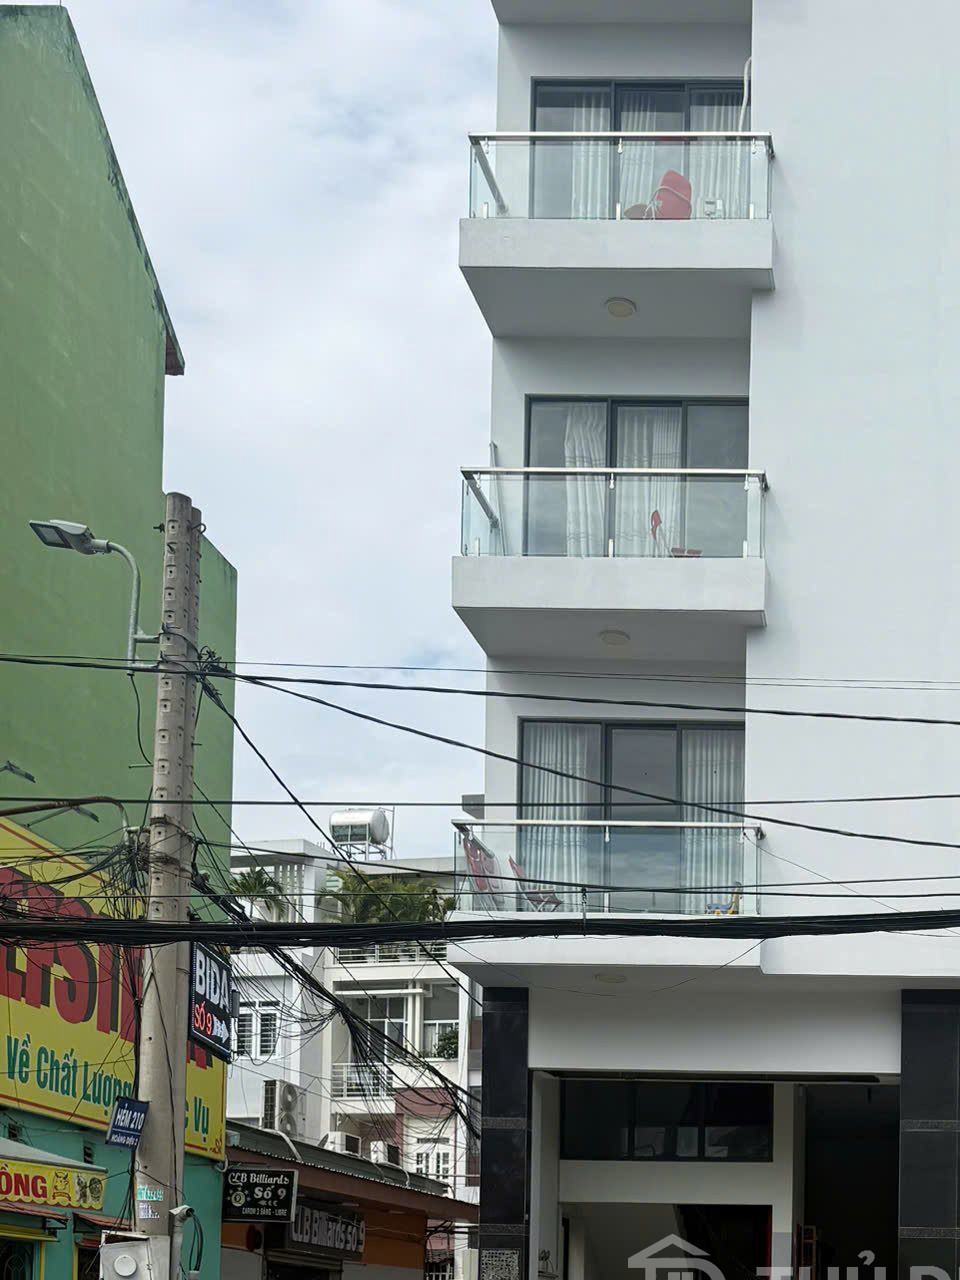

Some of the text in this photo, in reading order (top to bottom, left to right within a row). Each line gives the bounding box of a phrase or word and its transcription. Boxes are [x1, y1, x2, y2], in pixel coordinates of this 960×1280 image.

[196, 948, 230, 1015] BIDA
[206, 1012, 213, 1036] 9
[7, 1033, 31, 1084] Về
[36, 1048, 77, 1098] Chất
[130, 1111, 145, 1130] 210
[194, 1095, 209, 1143] Vụ
[249, 1173, 290, 1185] Billiards
[253, 1185, 287, 1200] Số 9
